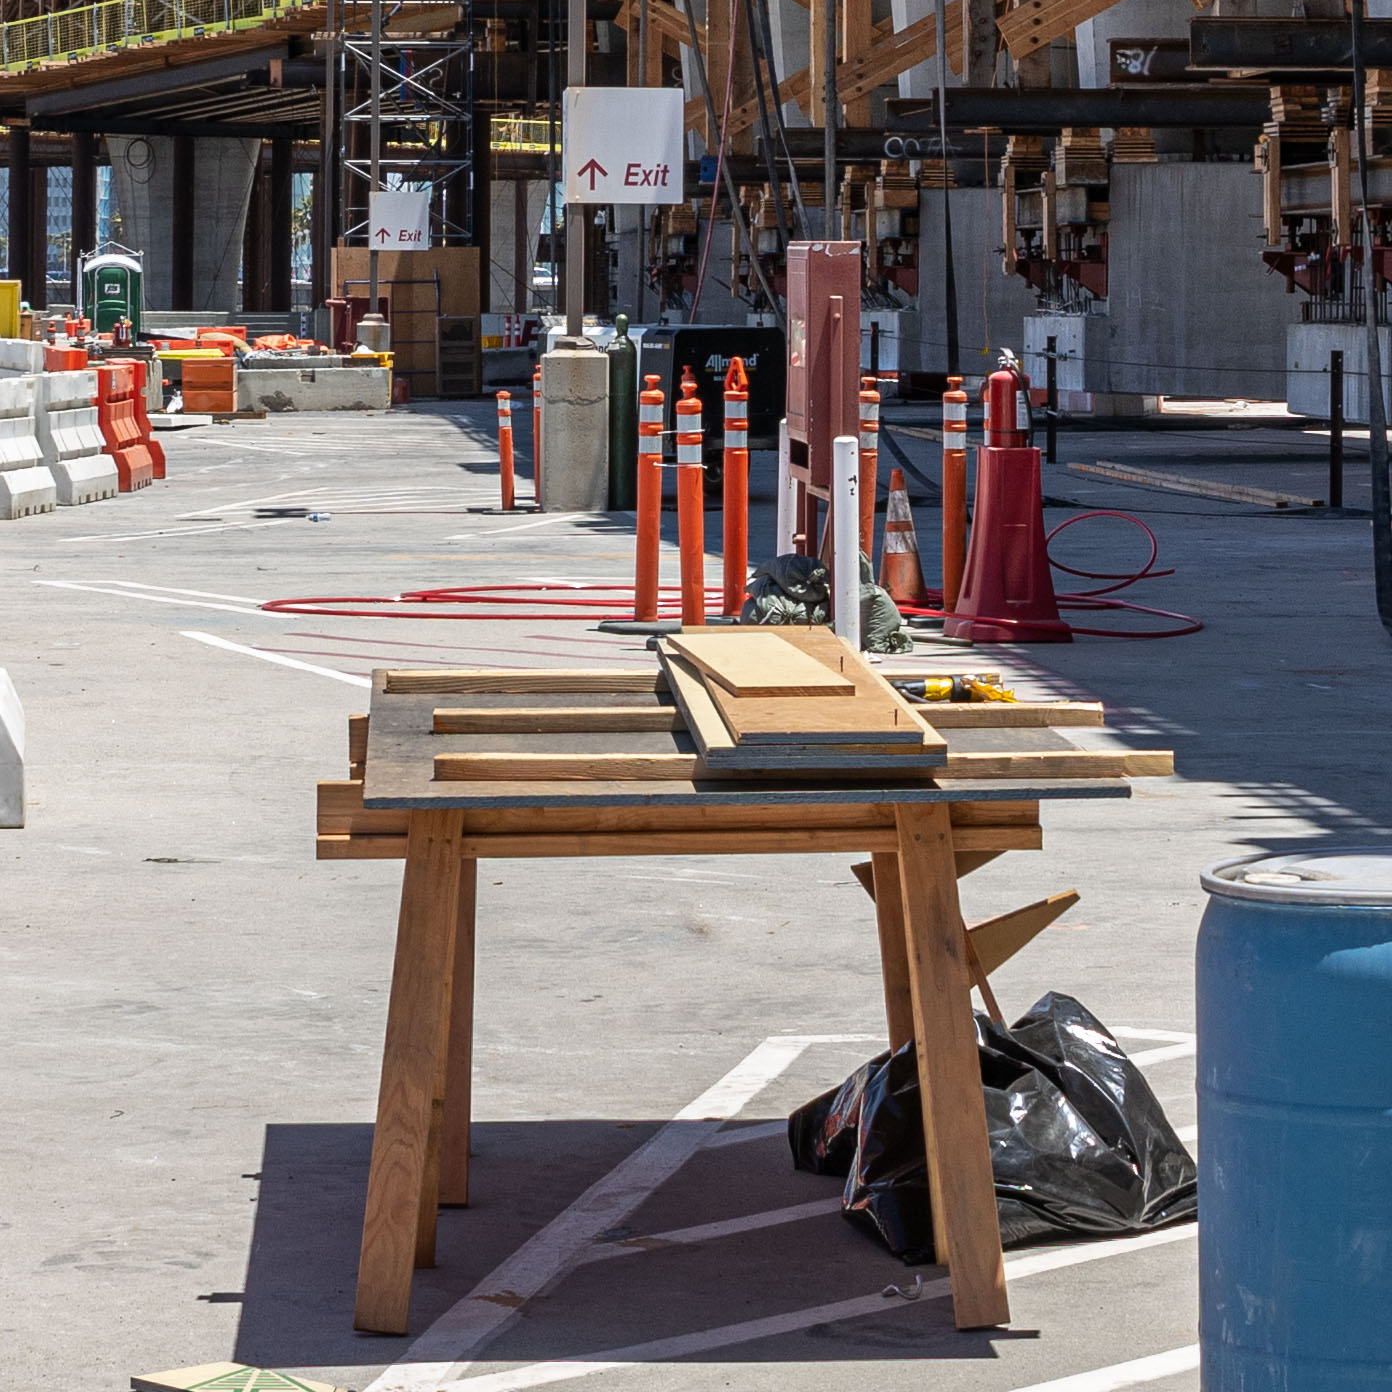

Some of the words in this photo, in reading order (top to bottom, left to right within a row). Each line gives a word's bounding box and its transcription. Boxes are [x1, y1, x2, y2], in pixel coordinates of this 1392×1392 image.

[624, 162, 670, 187] Exit
[398, 229, 422, 242] Exit
[705, 353, 758, 372] Allmnd
